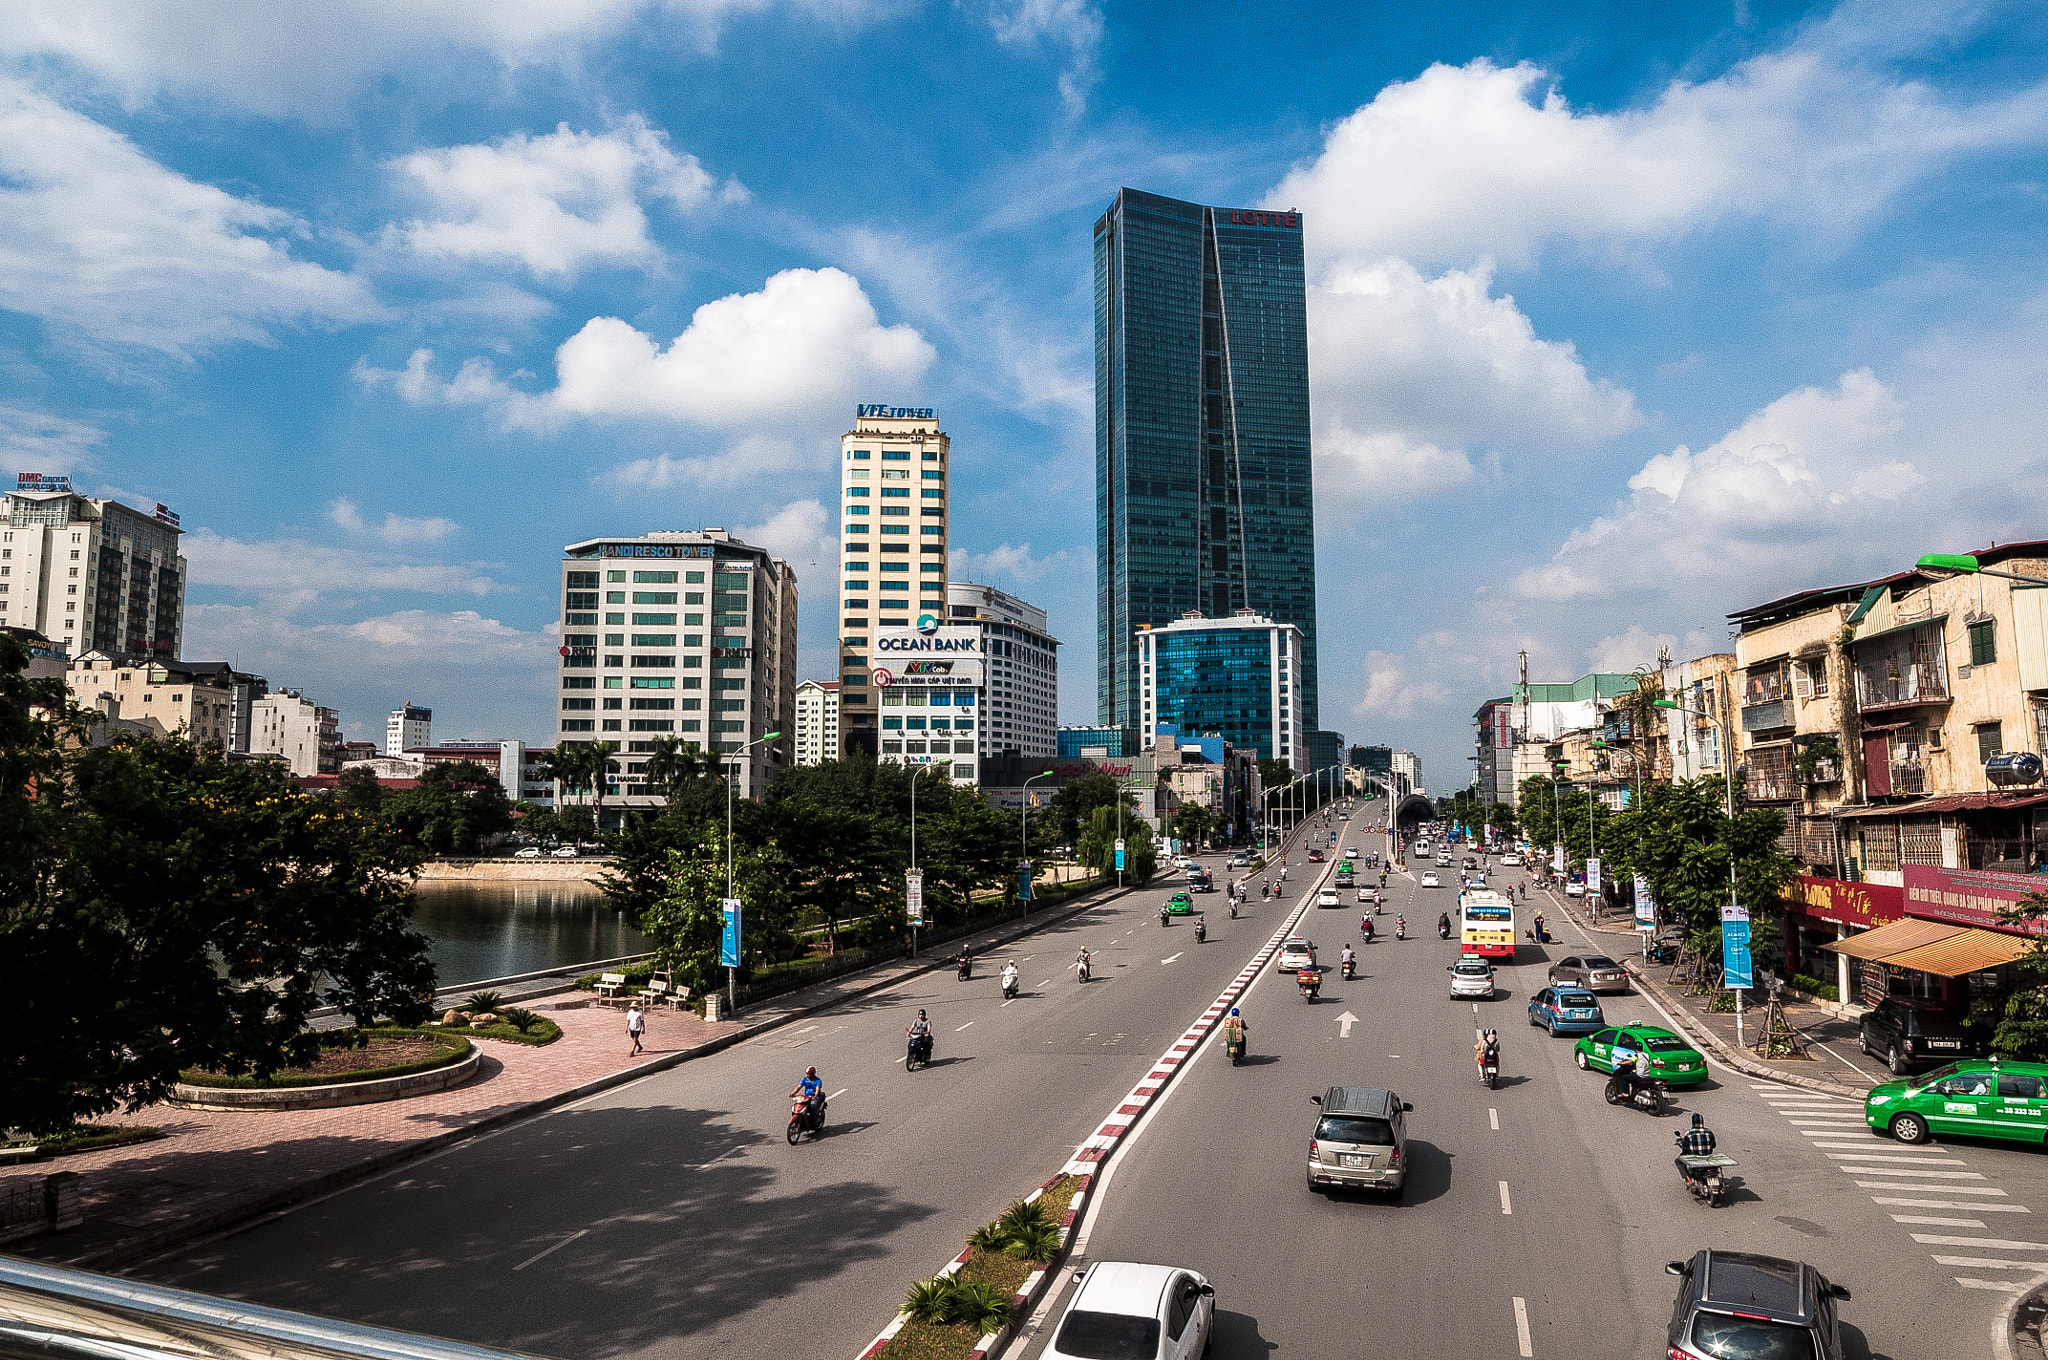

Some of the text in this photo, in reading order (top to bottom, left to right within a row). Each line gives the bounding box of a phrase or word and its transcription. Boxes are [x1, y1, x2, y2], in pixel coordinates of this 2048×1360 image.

[1231, 210, 1296, 227] LOTTE
[857, 403, 934, 418] VIT TOWER
[18, 472, 42, 482] DMC
[674, 546, 715, 557] TOWER
[27, 638, 52, 649] SAVOY
[878, 638, 976, 651] OCEAN BANK
[724, 647, 753, 658] RMIT
[1096, 762, 1131, 776] Mart
